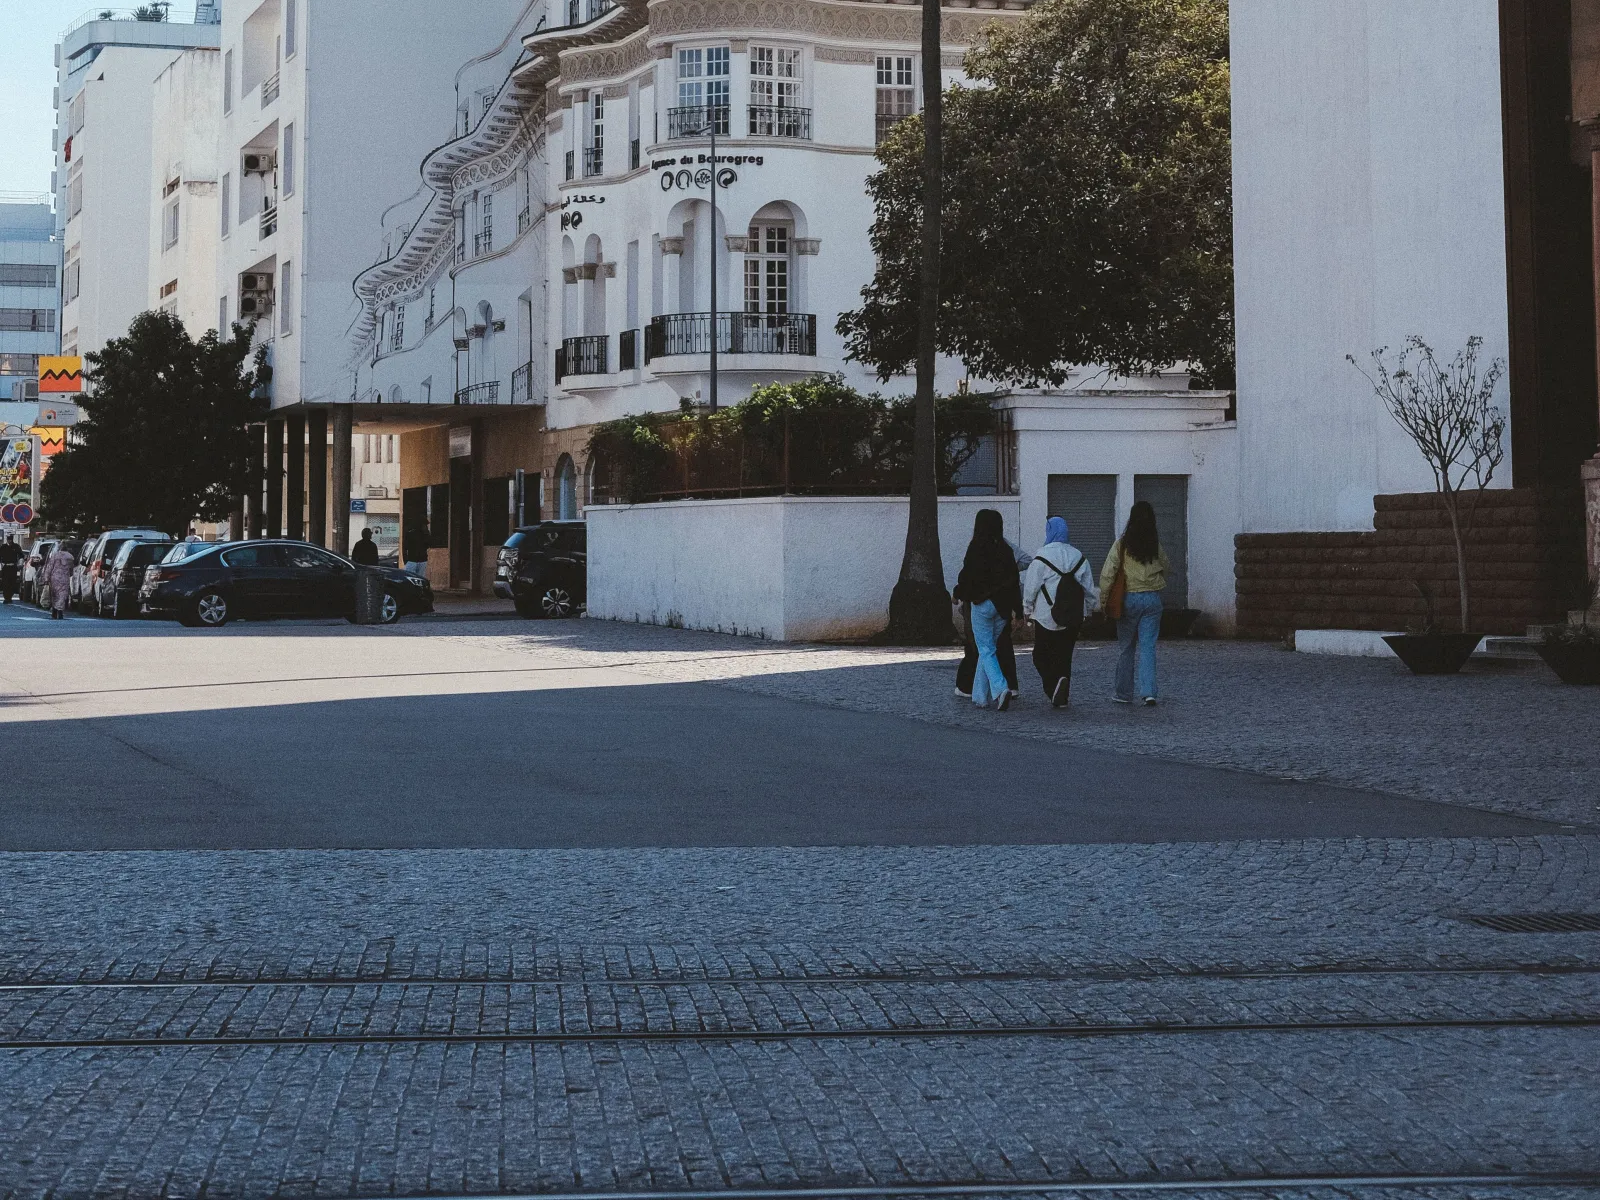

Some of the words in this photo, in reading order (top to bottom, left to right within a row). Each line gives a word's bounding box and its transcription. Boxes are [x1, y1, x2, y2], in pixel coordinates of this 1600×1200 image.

[680, 155, 693, 165] du
[697, 154, 764, 166] Bouregreg
[572, 194, 606, 204] وكالة
